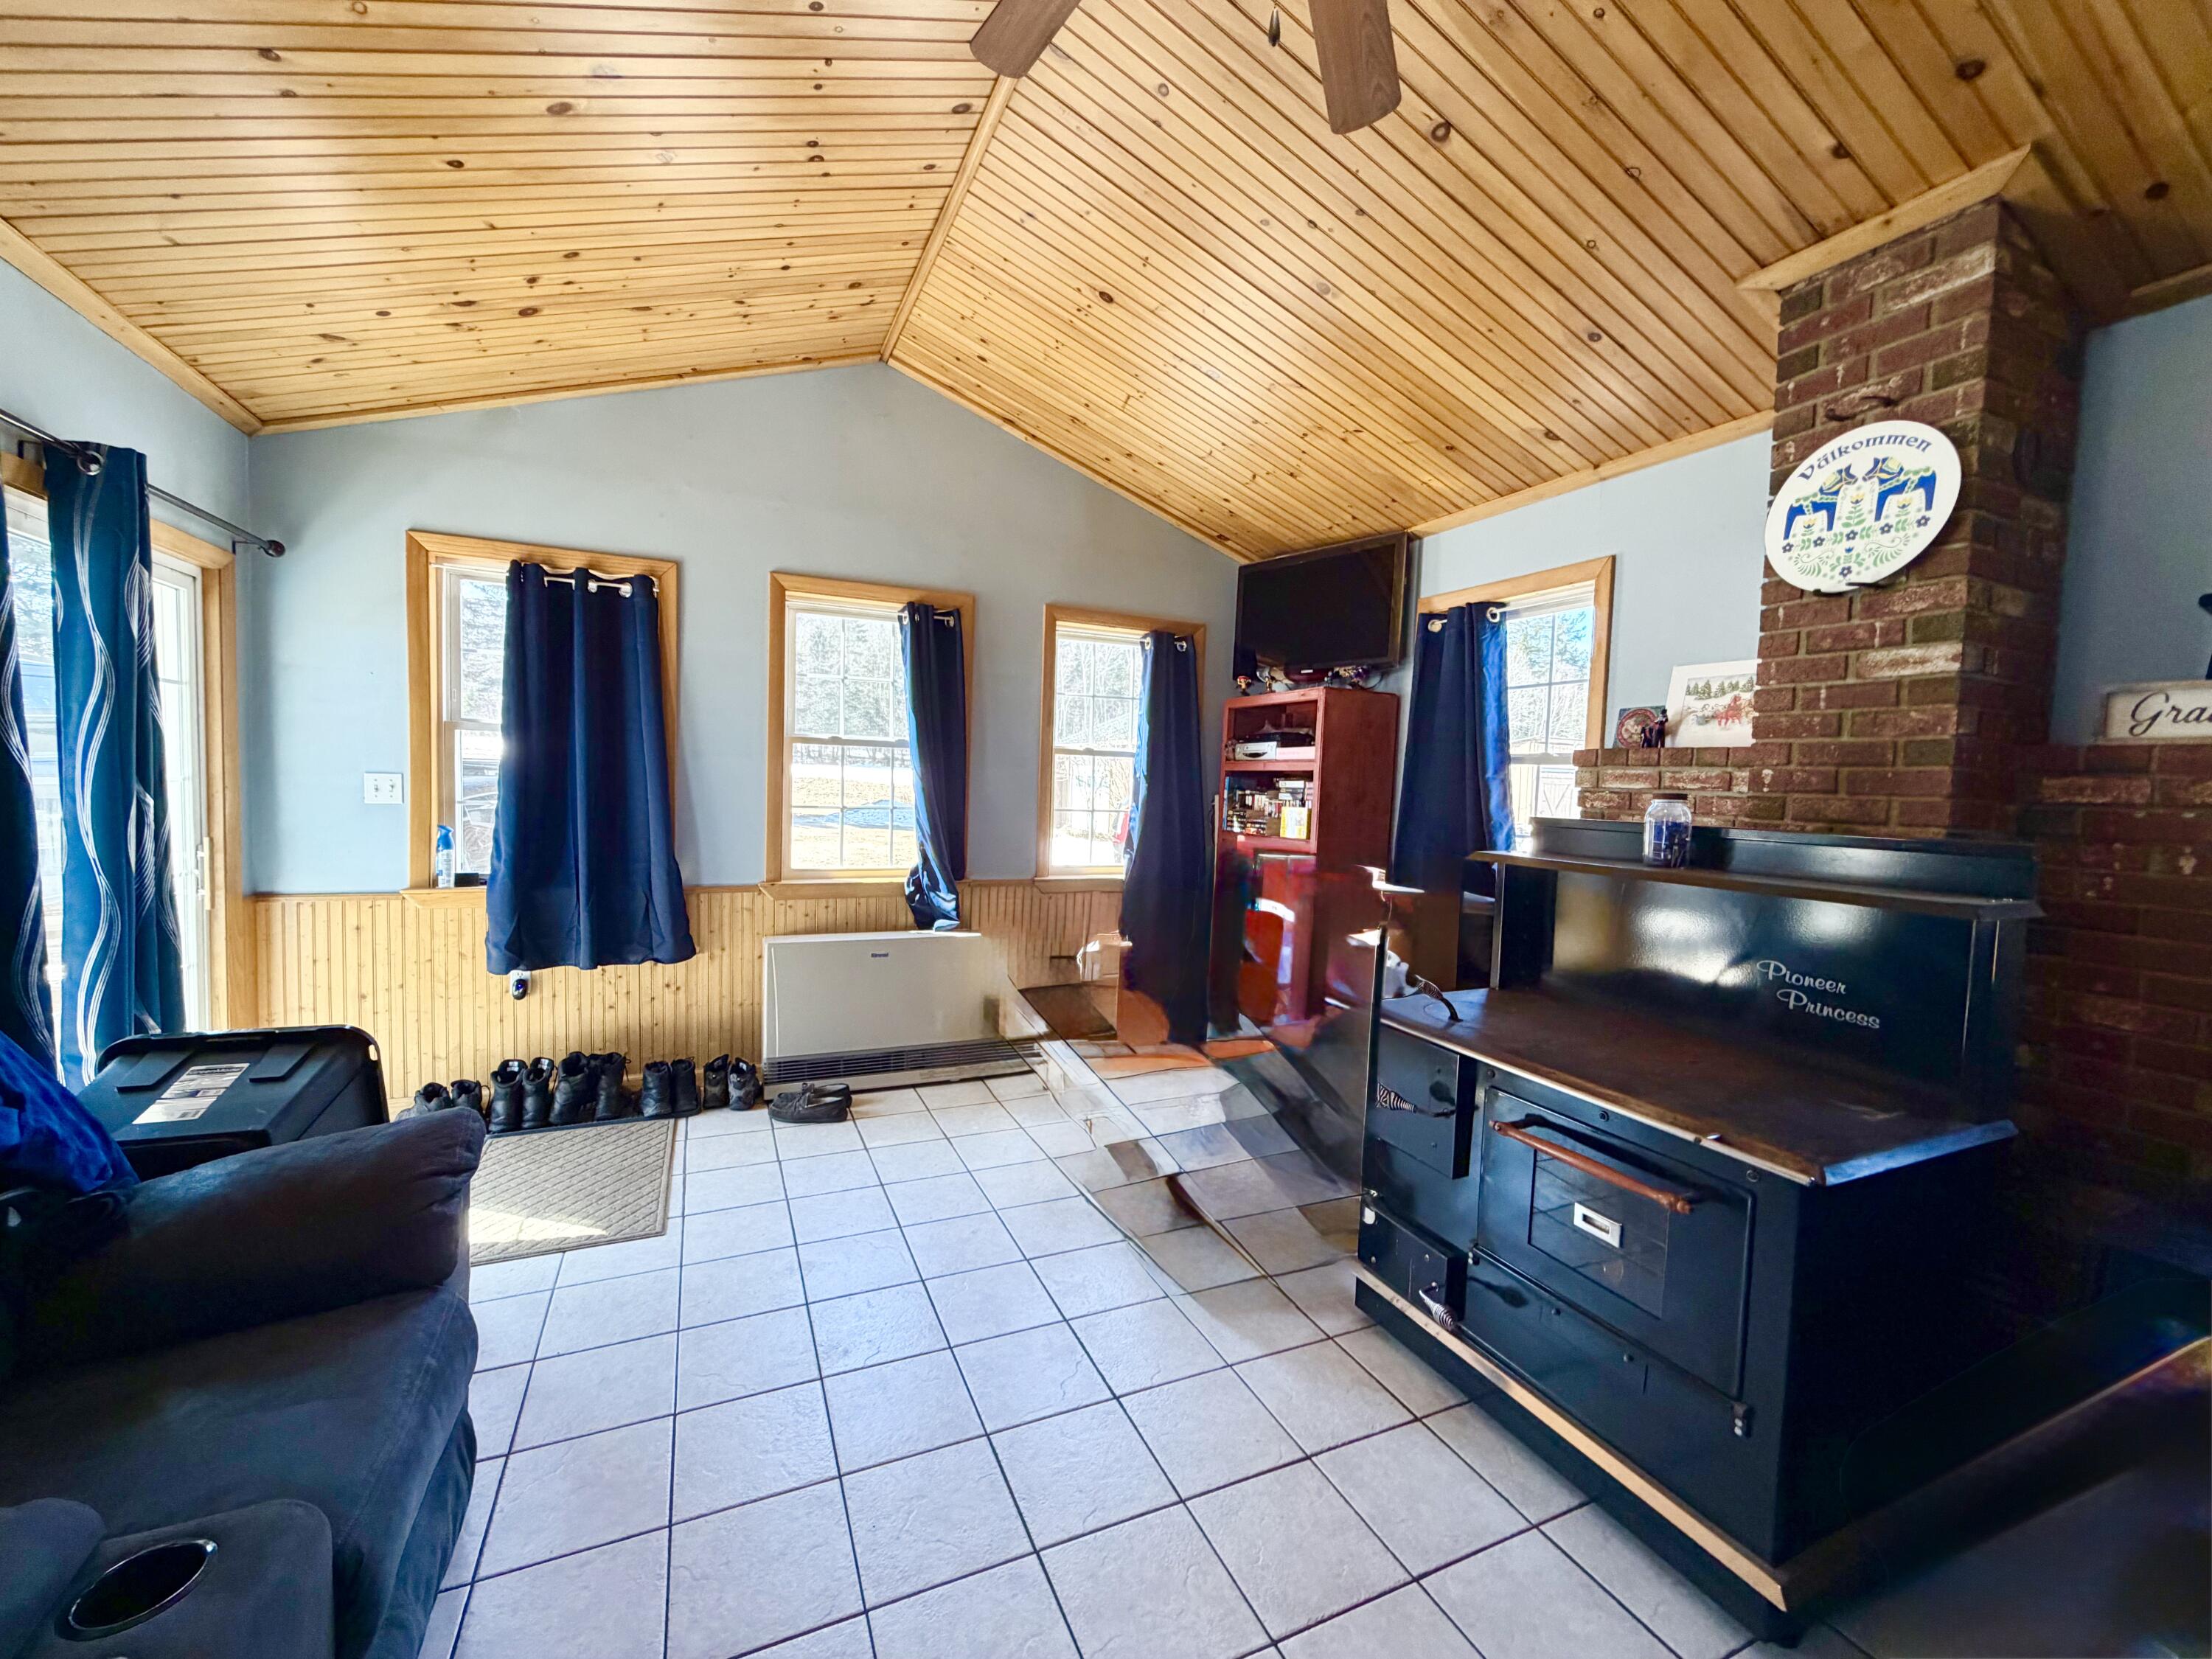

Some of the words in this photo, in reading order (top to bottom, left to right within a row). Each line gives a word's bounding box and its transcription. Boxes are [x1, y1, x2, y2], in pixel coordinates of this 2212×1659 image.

[1798, 434, 1932, 480] Välkommen
[2129, 692, 2212, 737] Gra
[1757, 960, 1846, 994] Pioneer
[1776, 989, 1880, 1029] Princess
